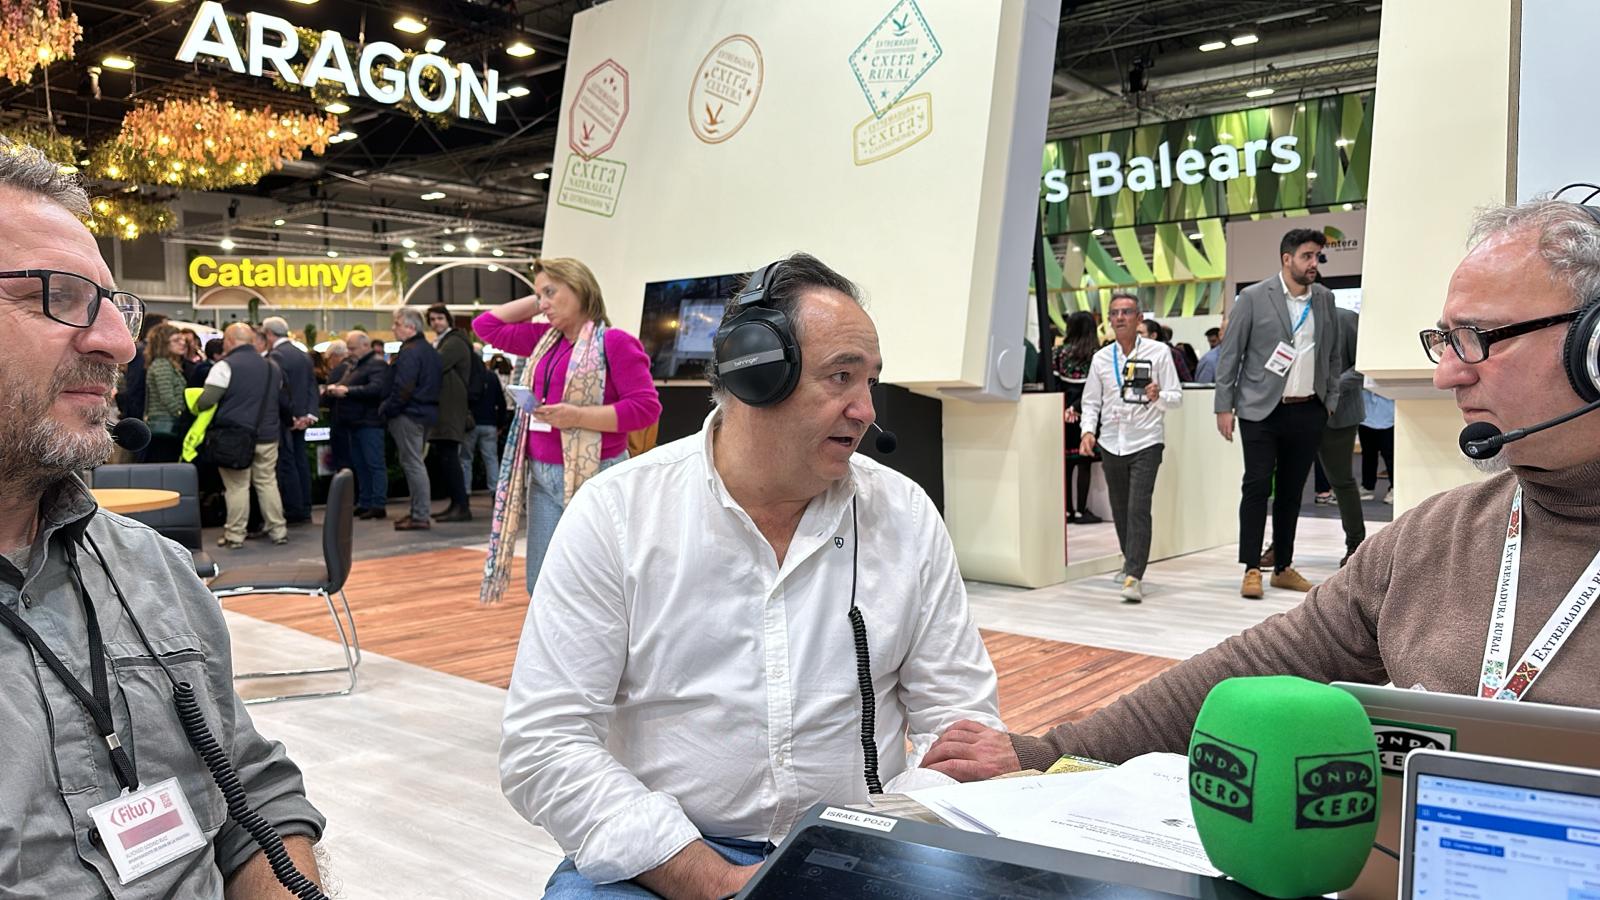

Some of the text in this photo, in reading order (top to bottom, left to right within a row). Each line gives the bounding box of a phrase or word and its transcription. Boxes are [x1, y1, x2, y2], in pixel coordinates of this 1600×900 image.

[175, 0, 499, 124] ARAGÓN
[871, 54, 914, 67] extra
[711, 66, 748, 90] extra
[869, 67, 911, 80] RURAL
[869, 116, 914, 146] extra
[571, 161, 617, 184] extra
[1088, 136, 1302, 197] Balears
[189, 255, 374, 293] Catalunya
[1490, 543, 1517, 655] EXTREMADURA RURAL
[1532, 586, 1598, 662] EXTREMADURA
[1376, 734, 1436, 750] ONDA
[1194, 744, 1241, 775] ONDA
[1379, 753, 1404, 767] CE
[1196, 772, 1241, 804] CERO
[1310, 768, 1369, 786] ONDA
[1313, 796, 1369, 817] CERO
[826, 810, 891, 828] ISRAEL POZO
